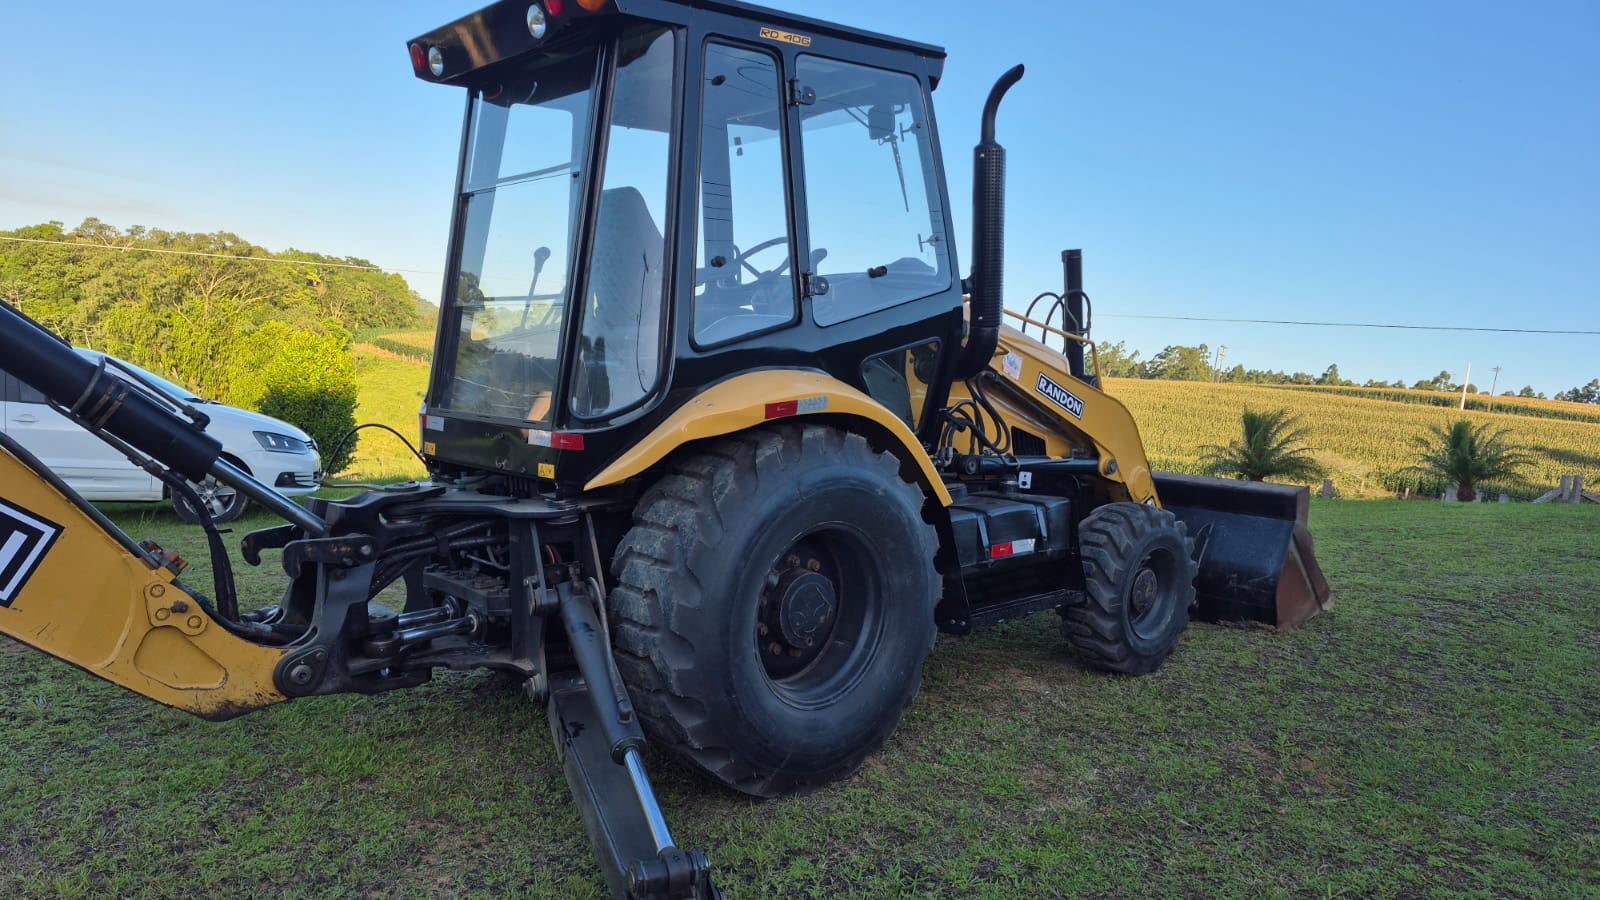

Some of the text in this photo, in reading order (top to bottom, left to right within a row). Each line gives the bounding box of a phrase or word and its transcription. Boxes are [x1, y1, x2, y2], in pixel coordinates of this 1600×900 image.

[761, 28, 810, 45] RD 406
[1039, 378, 1082, 415] RANDON
